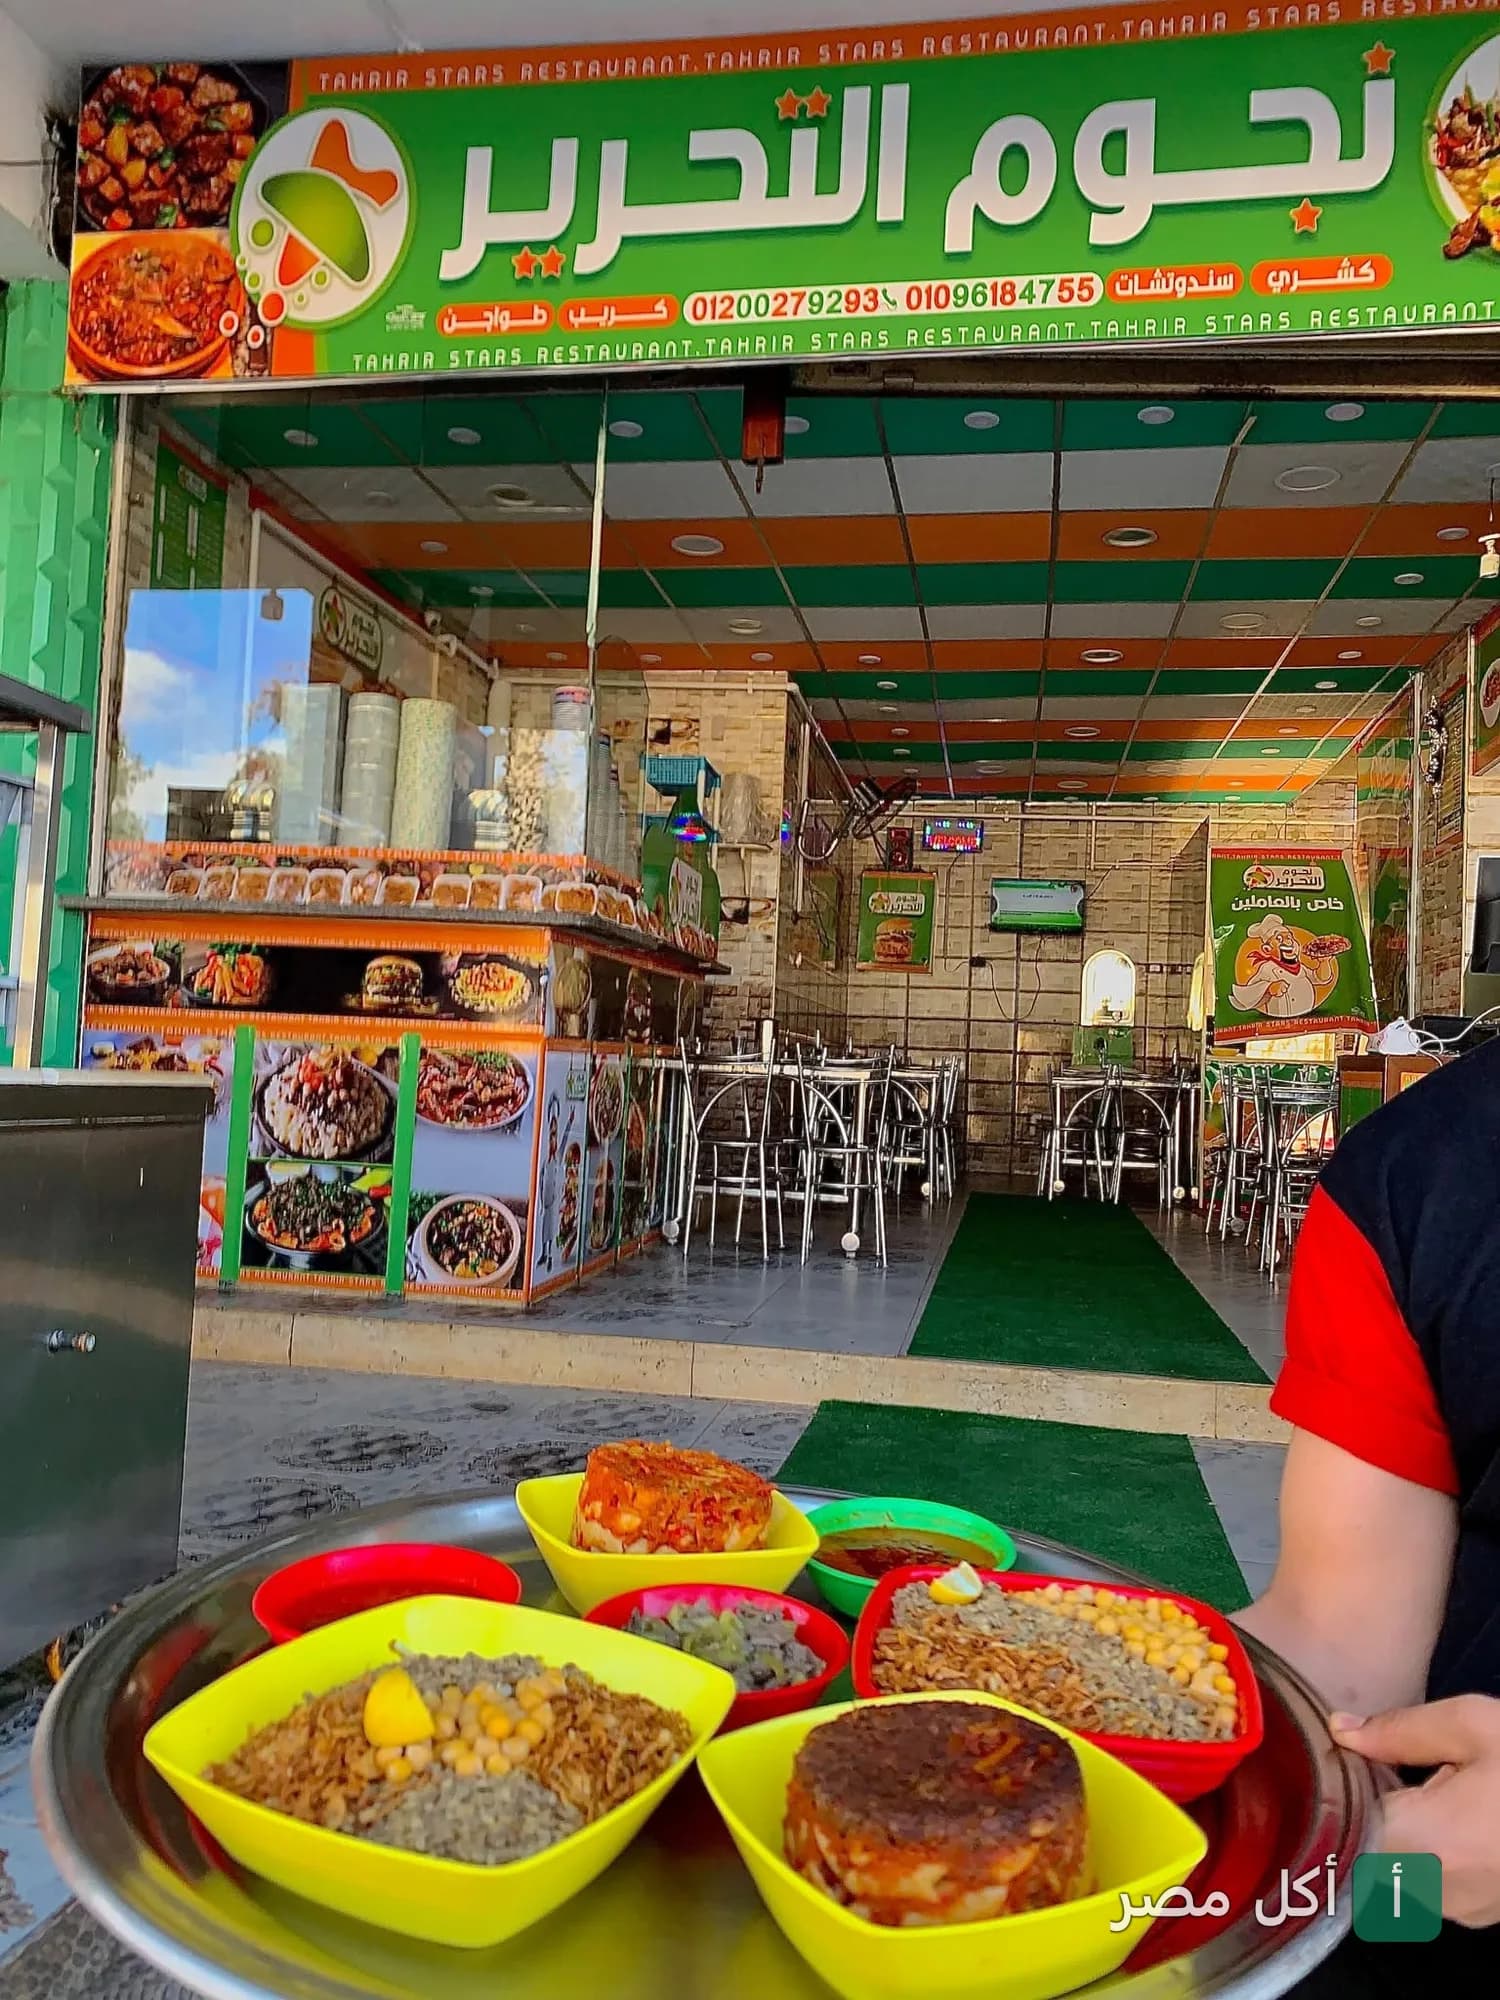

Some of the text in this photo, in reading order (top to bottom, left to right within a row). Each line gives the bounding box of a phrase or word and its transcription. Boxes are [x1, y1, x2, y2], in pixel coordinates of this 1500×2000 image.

[319, 70, 409, 92] TAHRIR
[425, 64, 504, 87] STARS
[819, 39, 905, 64] STARS
[1247, 1, 1340, 27] STARS
[438, 40, 1396, 282] نجوم التحرير
[1114, 268, 1235, 299] سندوتشات
[1266, 258, 1376, 293] كشري
[568, 299, 668, 327] كريب
[691, 276, 1095, 322] 01200279293 01096184755
[442, 304, 548, 333] طواجن
[353, 351, 435, 371] TAHRIR
[449, 347, 522, 367] STARS
[810, 329, 889, 352] STARS
[1205, 311, 1291, 334] STARS
[1310, 300, 1495, 329] RESTAURANT
[929, 834, 977, 848] WELCOME
[1231, 894, 1344, 912] خاص بالعاملين
